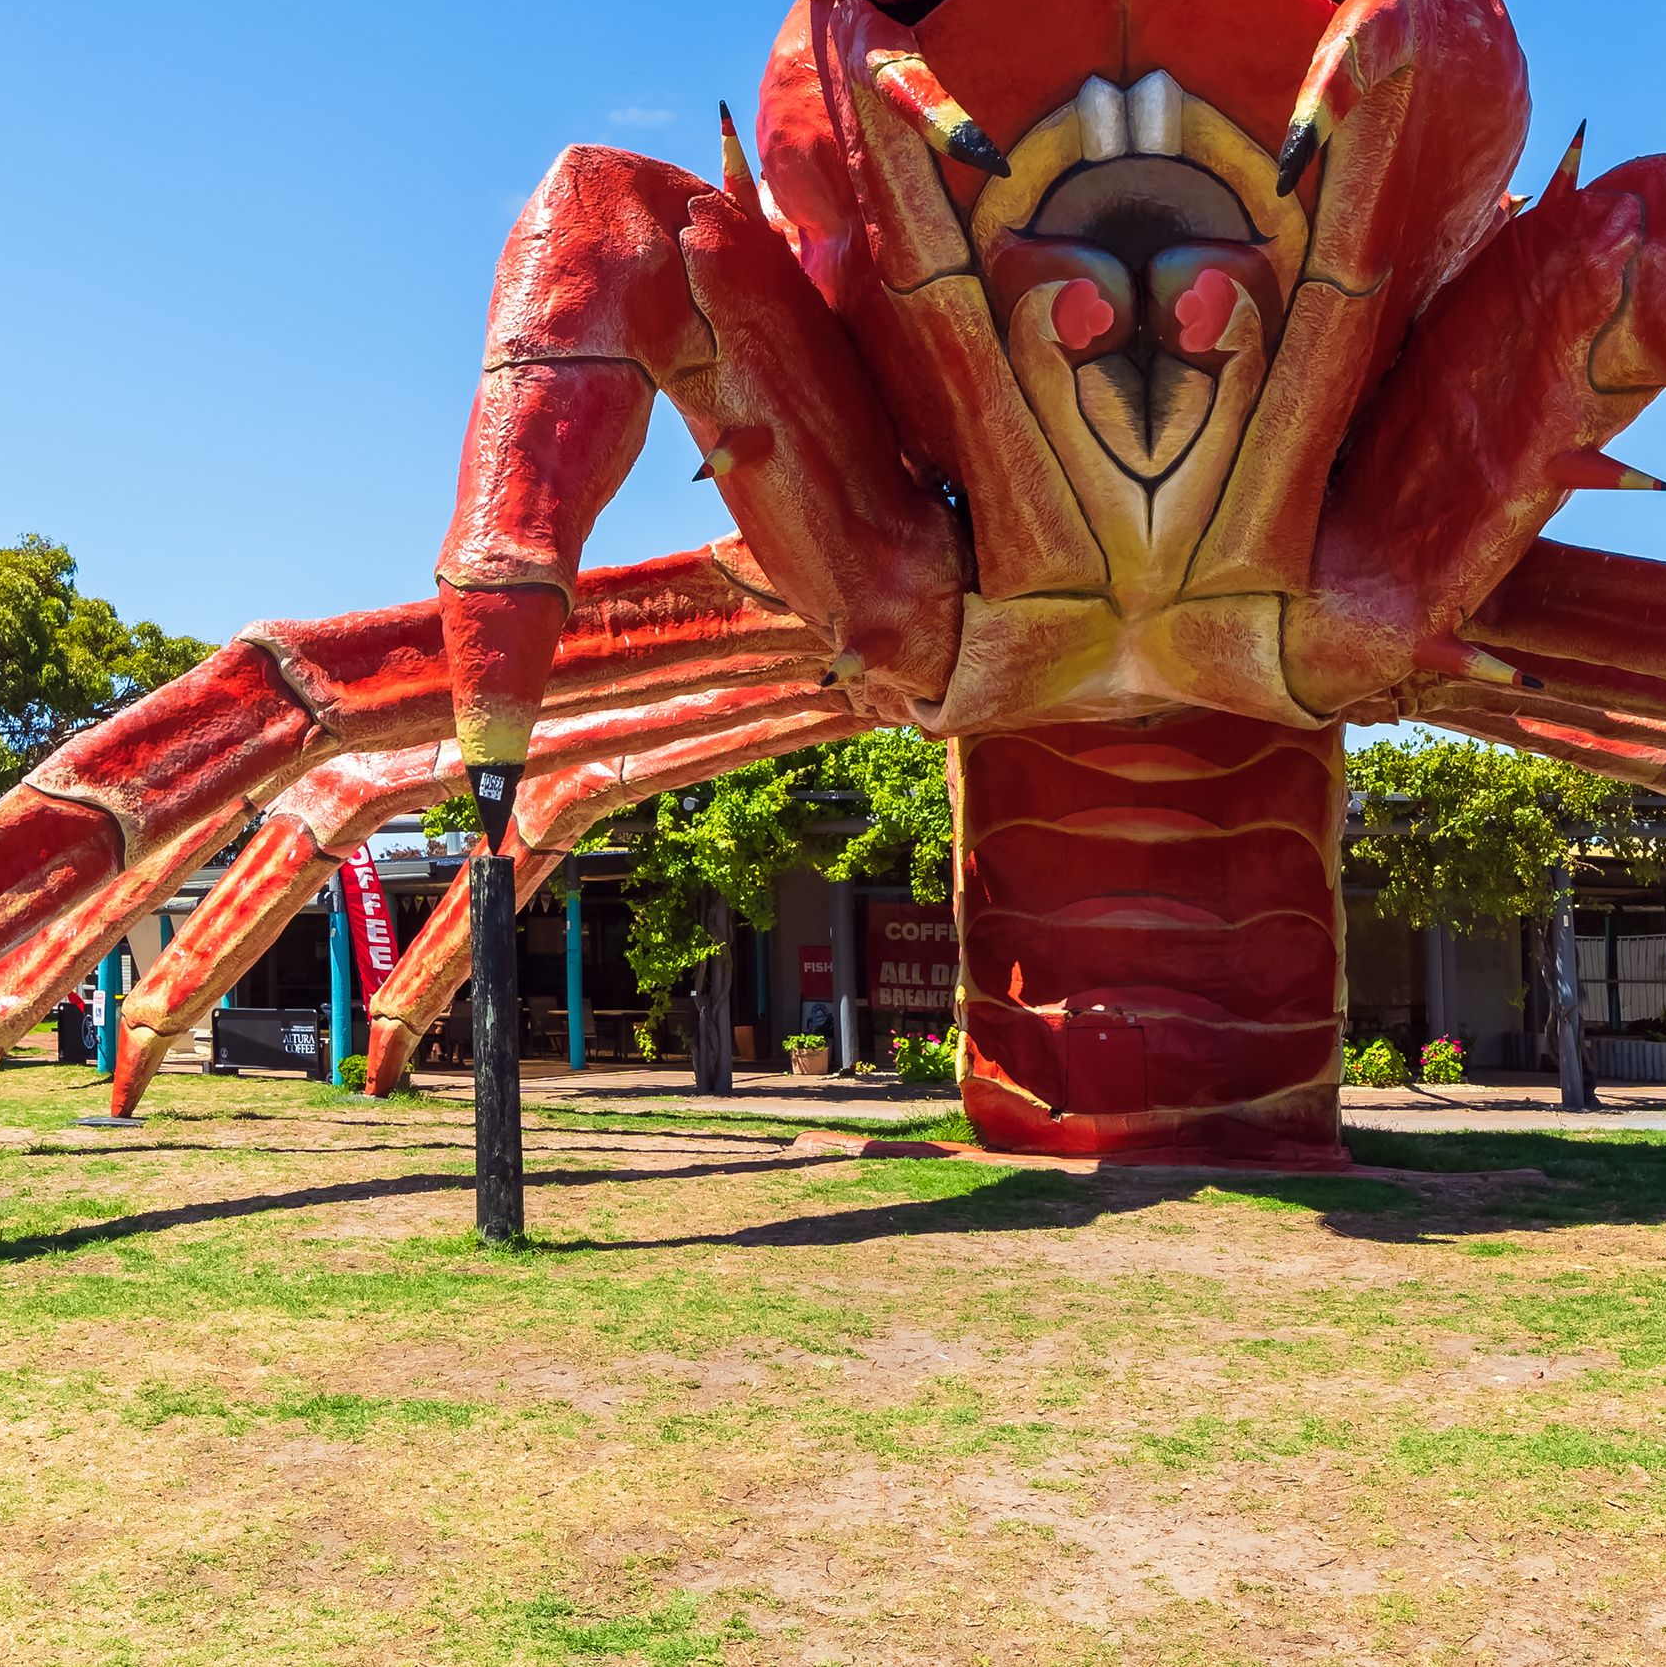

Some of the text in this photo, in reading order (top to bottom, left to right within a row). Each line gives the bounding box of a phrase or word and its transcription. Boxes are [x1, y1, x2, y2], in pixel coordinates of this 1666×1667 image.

[347, 845, 394, 971] OFFEE
[885, 921, 958, 942] COFFE
[804, 962, 833, 973] FISH
[879, 961, 925, 986] ALL
[282, 1033, 316, 1044] ALTURA
[285, 1043, 316, 1054] COFFEE
